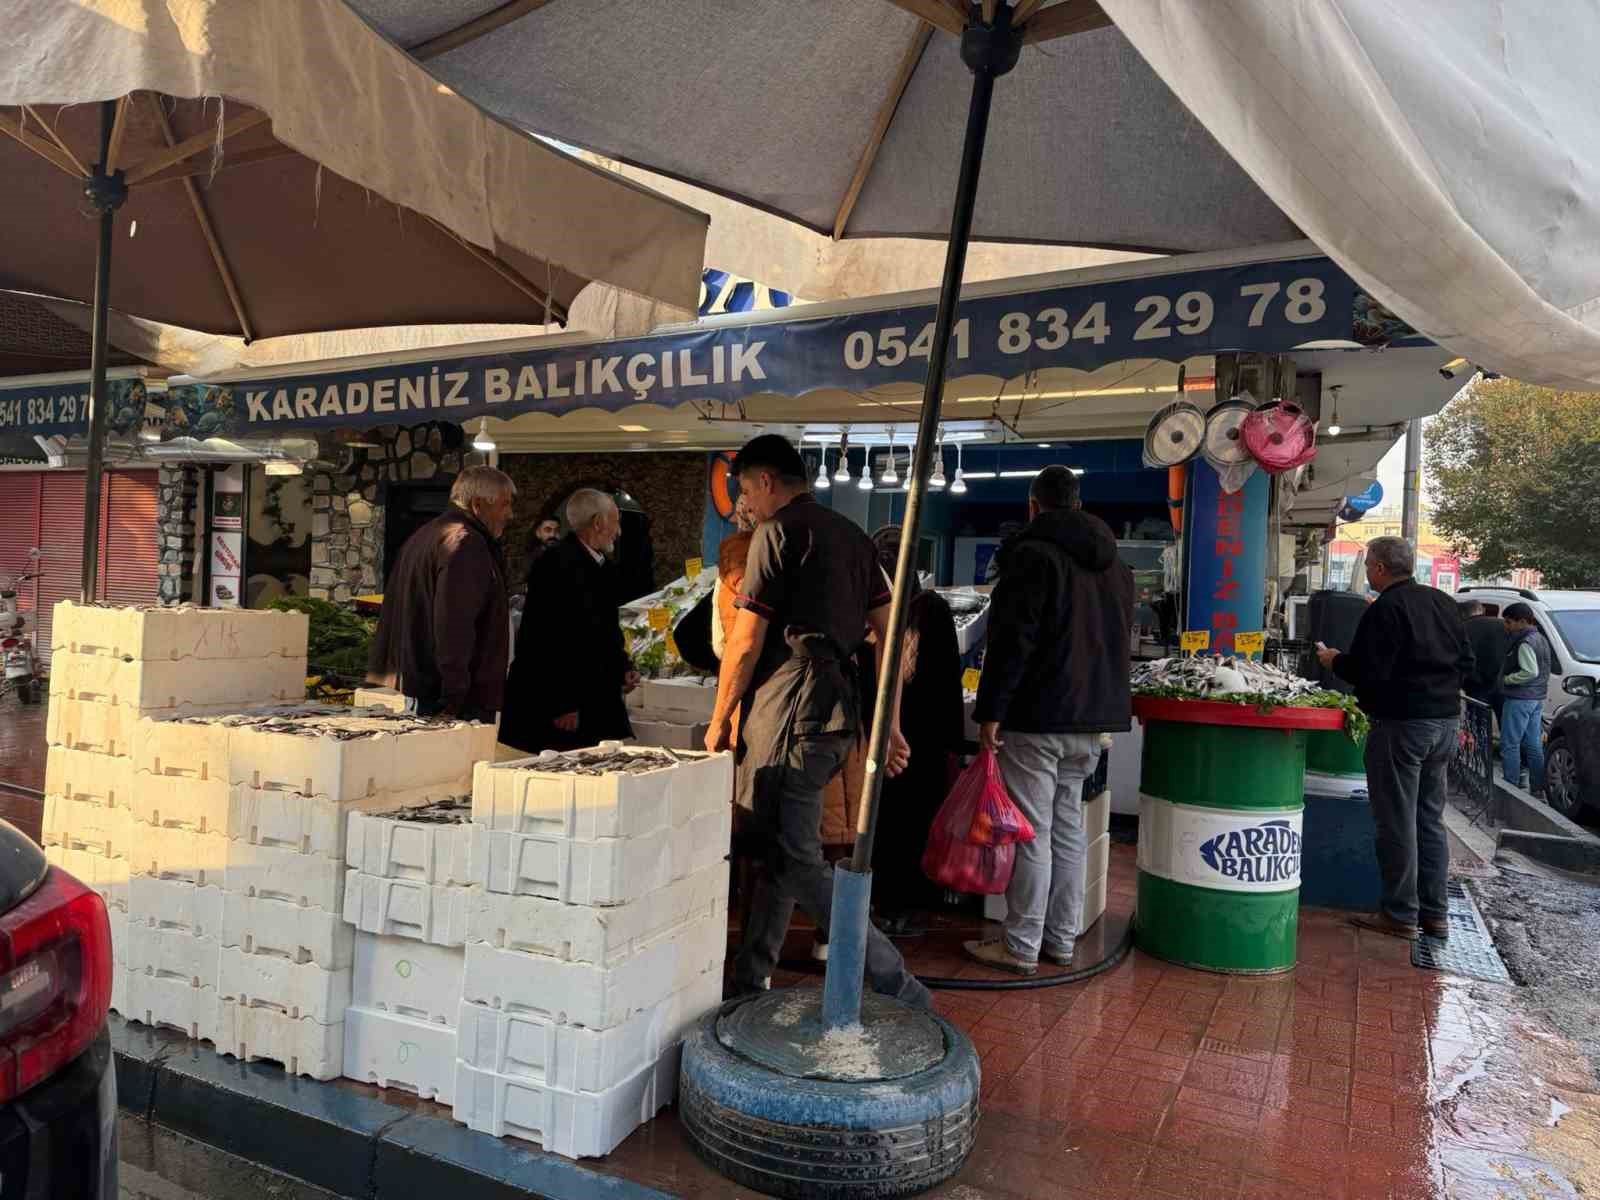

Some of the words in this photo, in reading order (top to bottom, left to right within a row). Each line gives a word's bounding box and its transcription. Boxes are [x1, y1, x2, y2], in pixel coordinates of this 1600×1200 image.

[245, 366, 469, 422] KARADENİZ
[484, 341, 767, 400] BALIKÇILIK
[843, 318, 970, 370] 0541
[998, 302, 1112, 354] 834
[1133, 291, 1214, 341] 29
[1240, 277, 1327, 327] 78
[27, 396, 54, 424] 834
[58, 395, 76, 422] 29
[80, 394, 91, 421] 7
